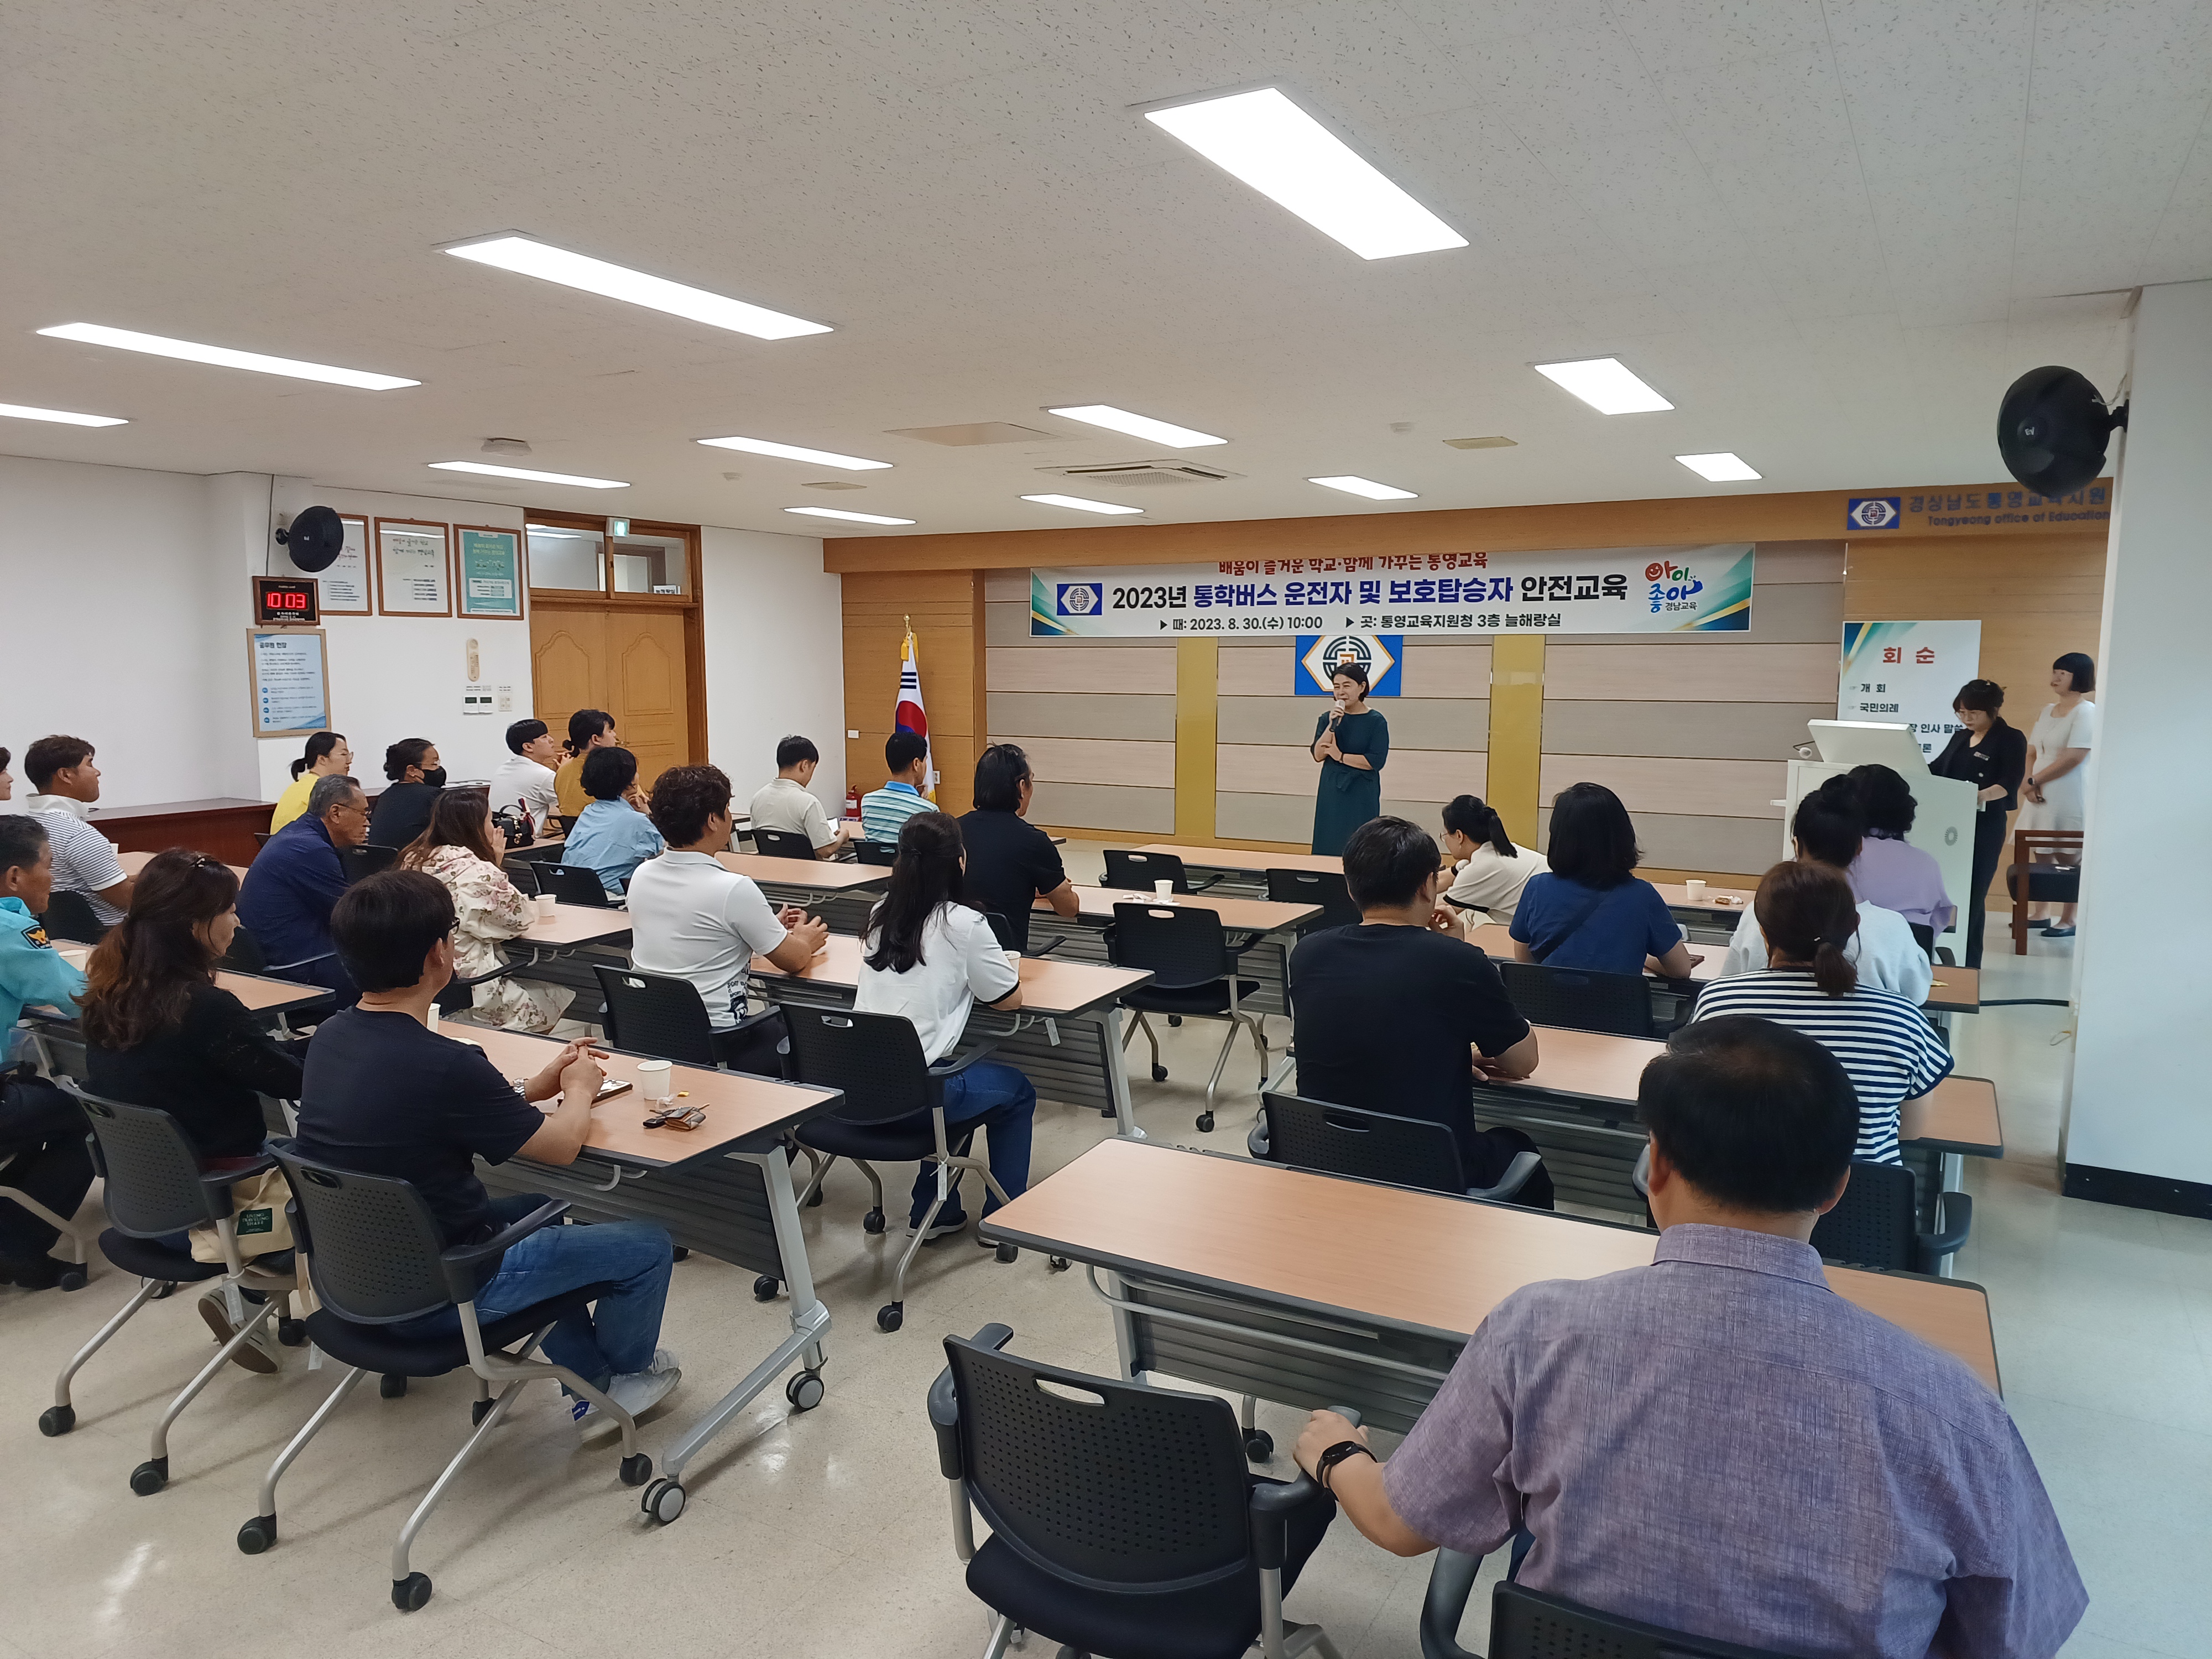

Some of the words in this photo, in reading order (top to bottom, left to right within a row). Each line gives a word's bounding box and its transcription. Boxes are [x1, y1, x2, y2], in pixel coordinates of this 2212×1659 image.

[1219, 560, 1259, 576] 배움이
[1264, 559, 1304, 575] 즐거운
[1379, 554, 1422, 570] 가꾸는
[1427, 552, 1488, 571] 통영교육
[1112, 586, 1187, 609] 2023년
[1193, 583, 1277, 608] 통학버스
[1284, 581, 1352, 606] 운전자
[1359, 580, 1380, 604] 및
[1389, 576, 1514, 603] 보호탑승자
[1521, 573, 1627, 602] 안전교육
[1665, 602, 1697, 611] 경남교육
[1172, 618, 1187, 630] 때:
[1190, 618, 1225, 630] 2023.
[1228, 617, 1239, 630] 8.
[1243, 616, 1284, 630] 30.(수)
[1287, 616, 1323, 629] 10:00
[1360, 615, 1376, 628] 곳:
[1380, 614, 1473, 628] 통영교육지원청
[1477, 613, 1500, 627] 3층
[1505, 613, 1561, 627] 늘해랑실
[1921, 723, 1940, 733] 인사
